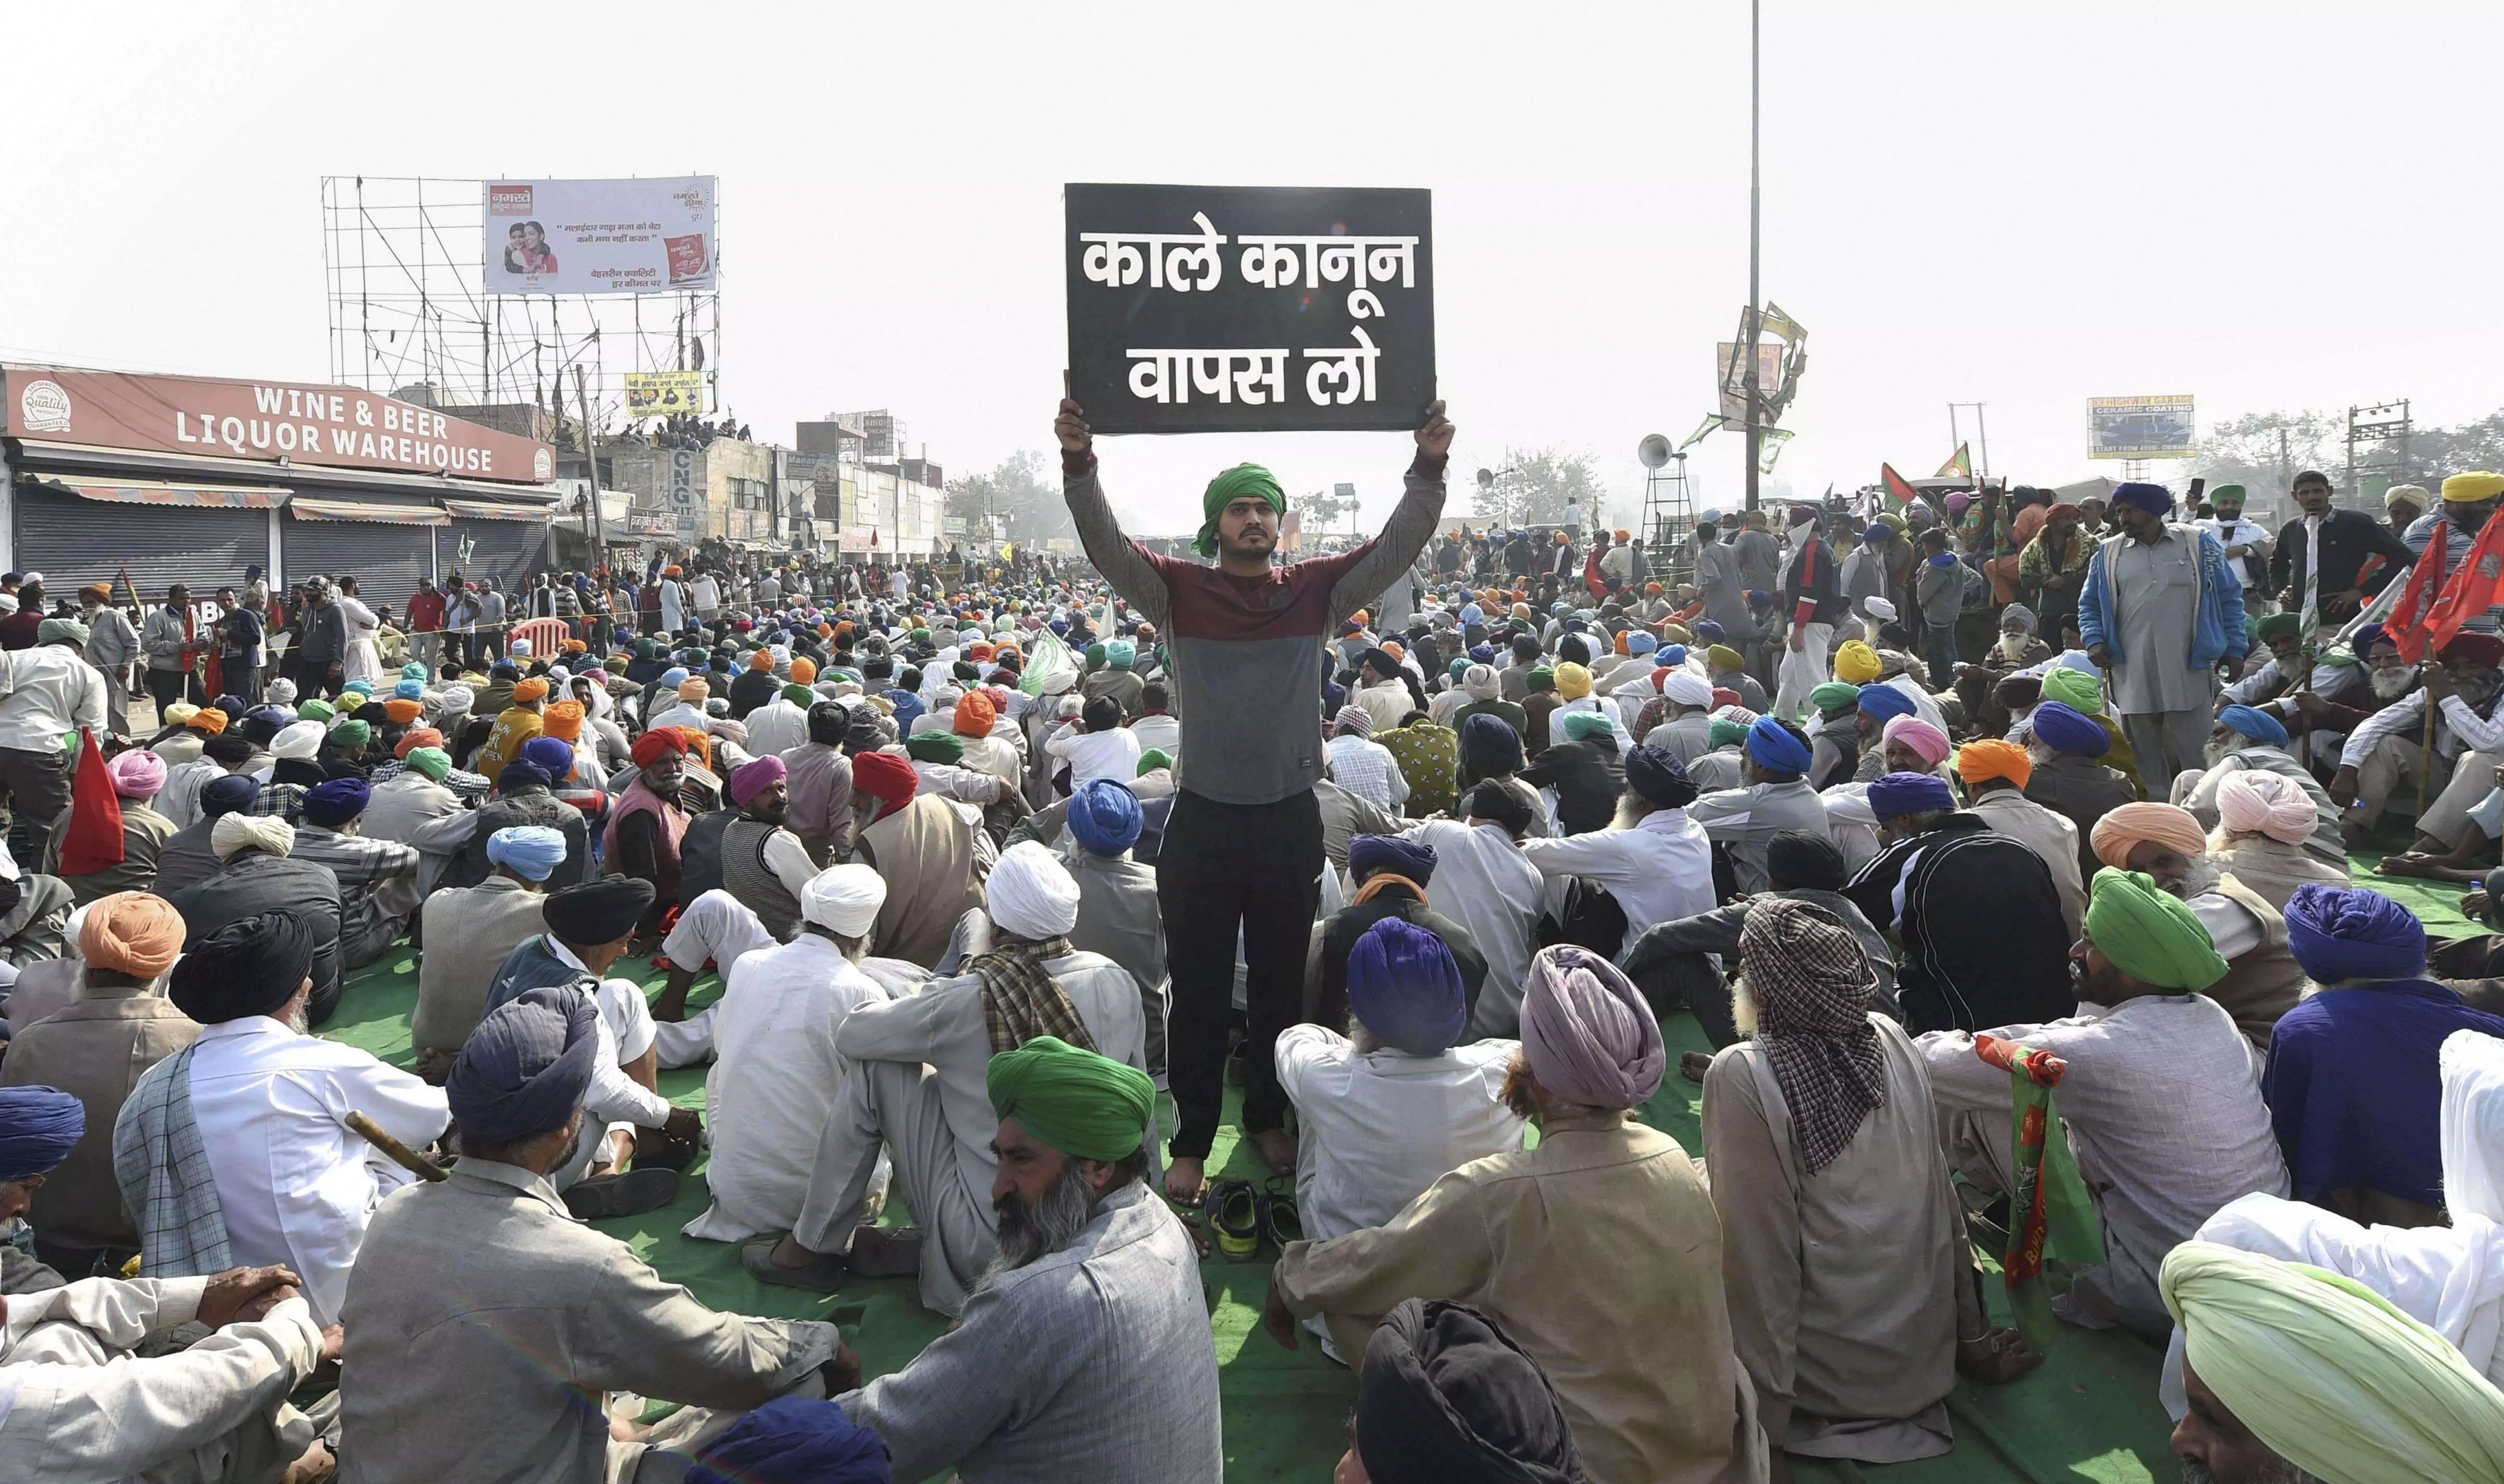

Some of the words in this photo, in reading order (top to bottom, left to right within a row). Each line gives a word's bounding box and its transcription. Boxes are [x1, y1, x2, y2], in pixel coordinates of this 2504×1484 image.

[491, 190, 531, 203] नमस्ते
[564, 223, 597, 232] मलाईदार
[636, 222, 646, 230] को
[577, 234, 593, 243] कभी
[612, 234, 628, 243] नहीं
[1080, 211, 1227, 292] काले
[1237, 235, 1419, 319] कानून
[591, 268, 622, 279] बेहतरीन
[624, 267, 656, 277] क्वालिटी
[624, 278, 648, 288] कीमत
[1125, 348, 1290, 405] वापस
[1303, 324, 1381, 406] लो
[25, 396, 67, 413] Quality
[2106, 397, 2151, 406] HIGHWAY
[2154, 396, 2193, 404] GARAGE
[254, 384, 345, 423] WINE
[355, 400, 375, 427] &
[384, 405, 448, 439] BEER
[177, 412, 322, 453] LIQUOR
[331, 428, 491, 472] WAREHOUSE
[673, 451, 690, 504] CNG
